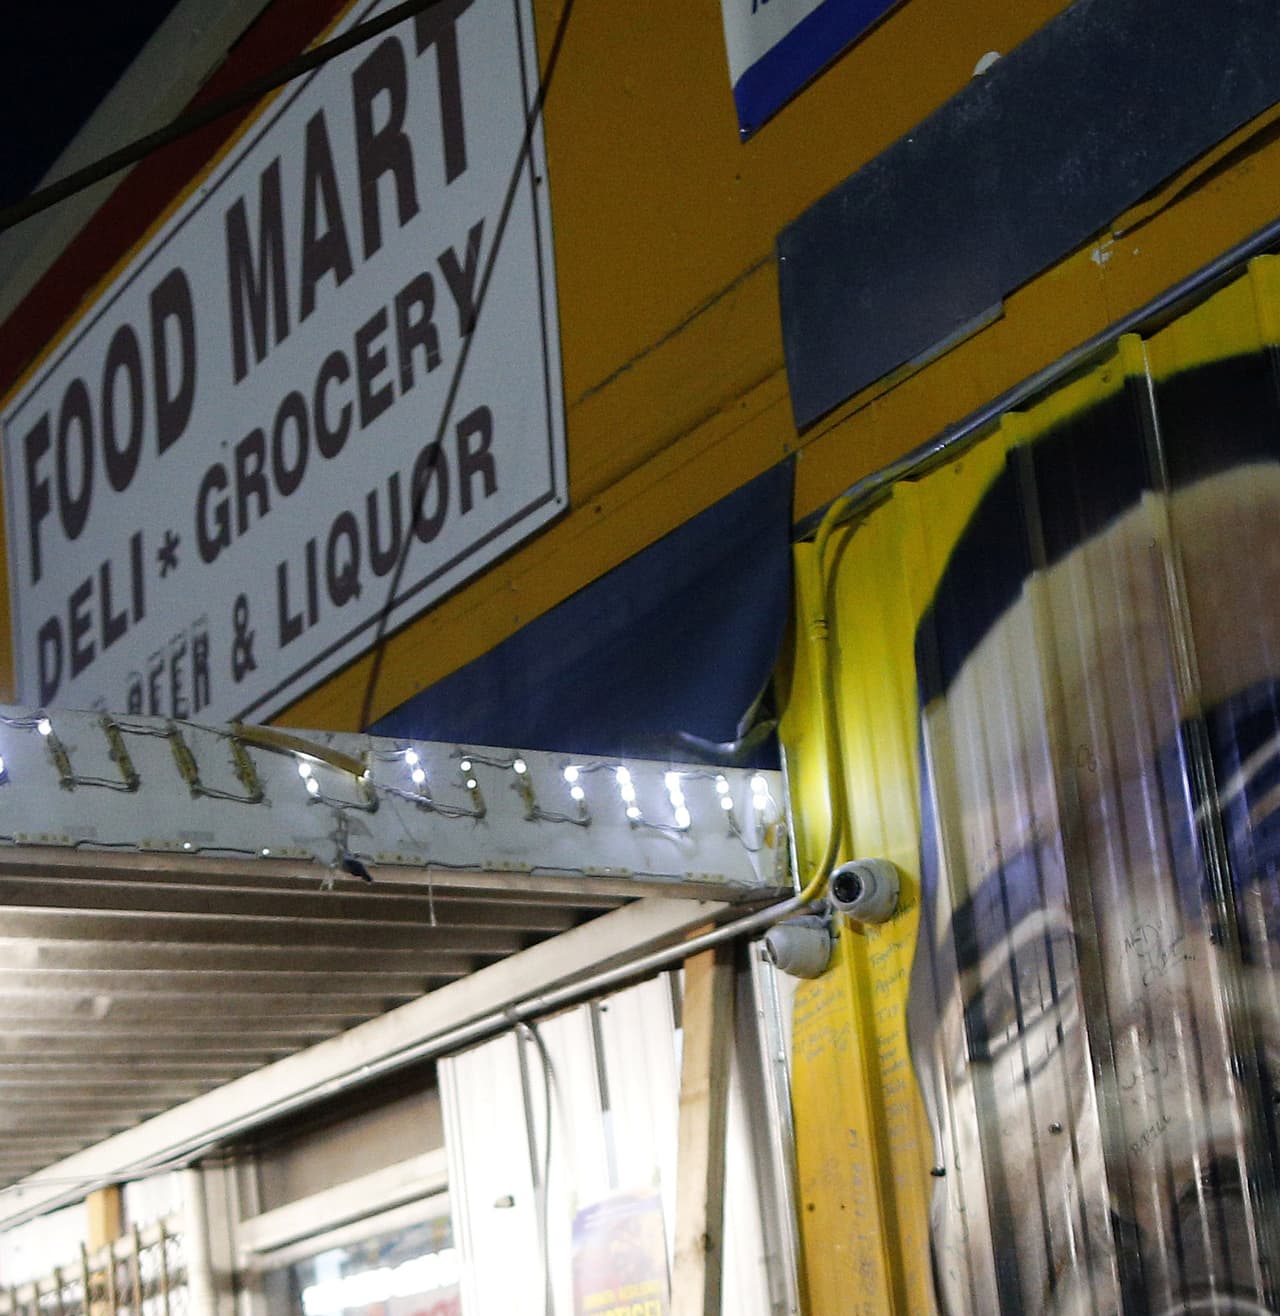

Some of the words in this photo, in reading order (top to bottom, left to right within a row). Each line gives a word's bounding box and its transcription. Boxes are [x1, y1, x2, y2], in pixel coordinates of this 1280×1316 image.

[22, 267, 198, 585] FOOD
[225, 0, 477, 384] MART
[37, 531, 146, 706] DELI
[196, 218, 486, 564] GROCERY
[232, 594, 258, 682] &
[277, 405, 498, 649] LIQUOR
